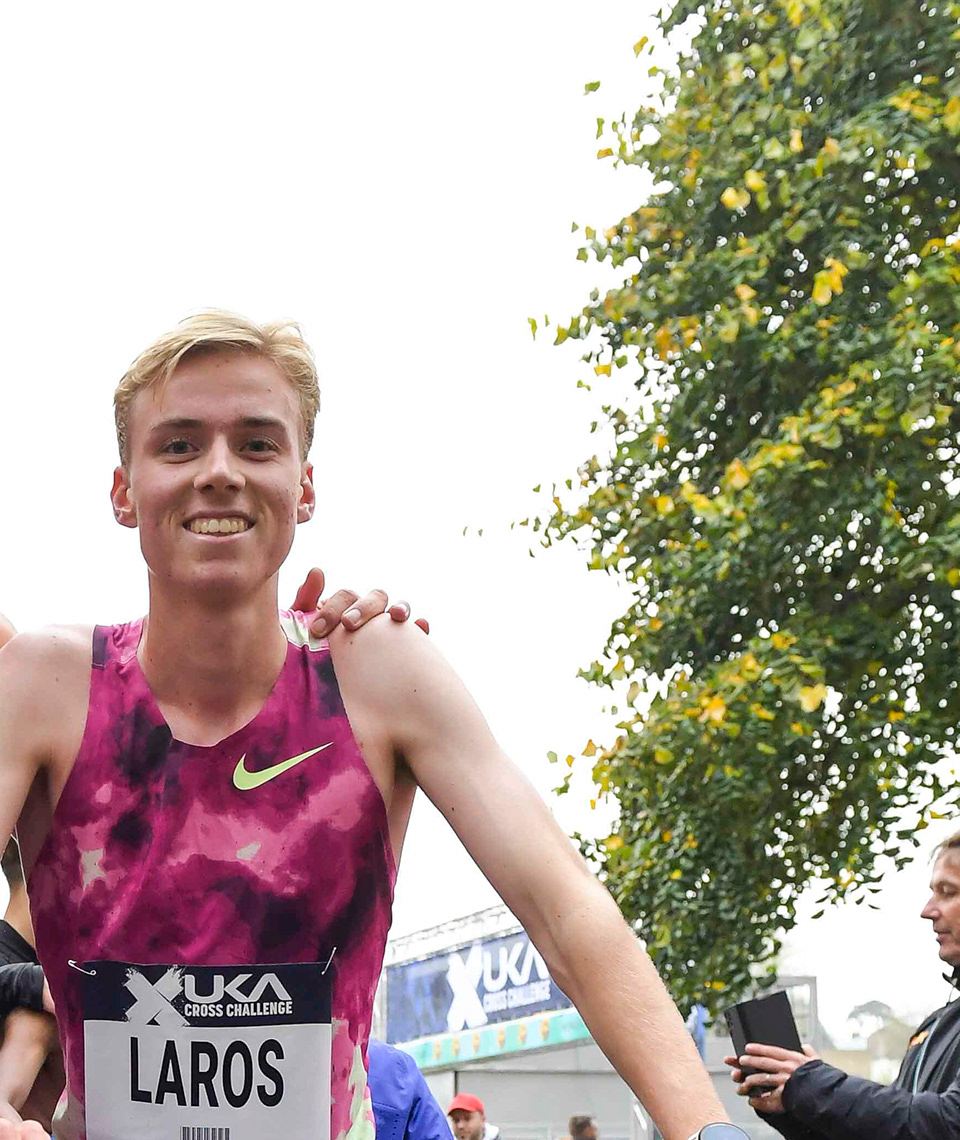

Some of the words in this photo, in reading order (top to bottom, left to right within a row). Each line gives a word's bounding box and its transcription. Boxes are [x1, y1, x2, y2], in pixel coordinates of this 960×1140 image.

[482, 941, 551, 993] UKA
[183, 973, 293, 1004] UKA
[183, 1002, 223, 1018] CROSS
[225, 1000, 293, 1017] CHALLENGE
[130, 1036, 285, 1108] LAROS
